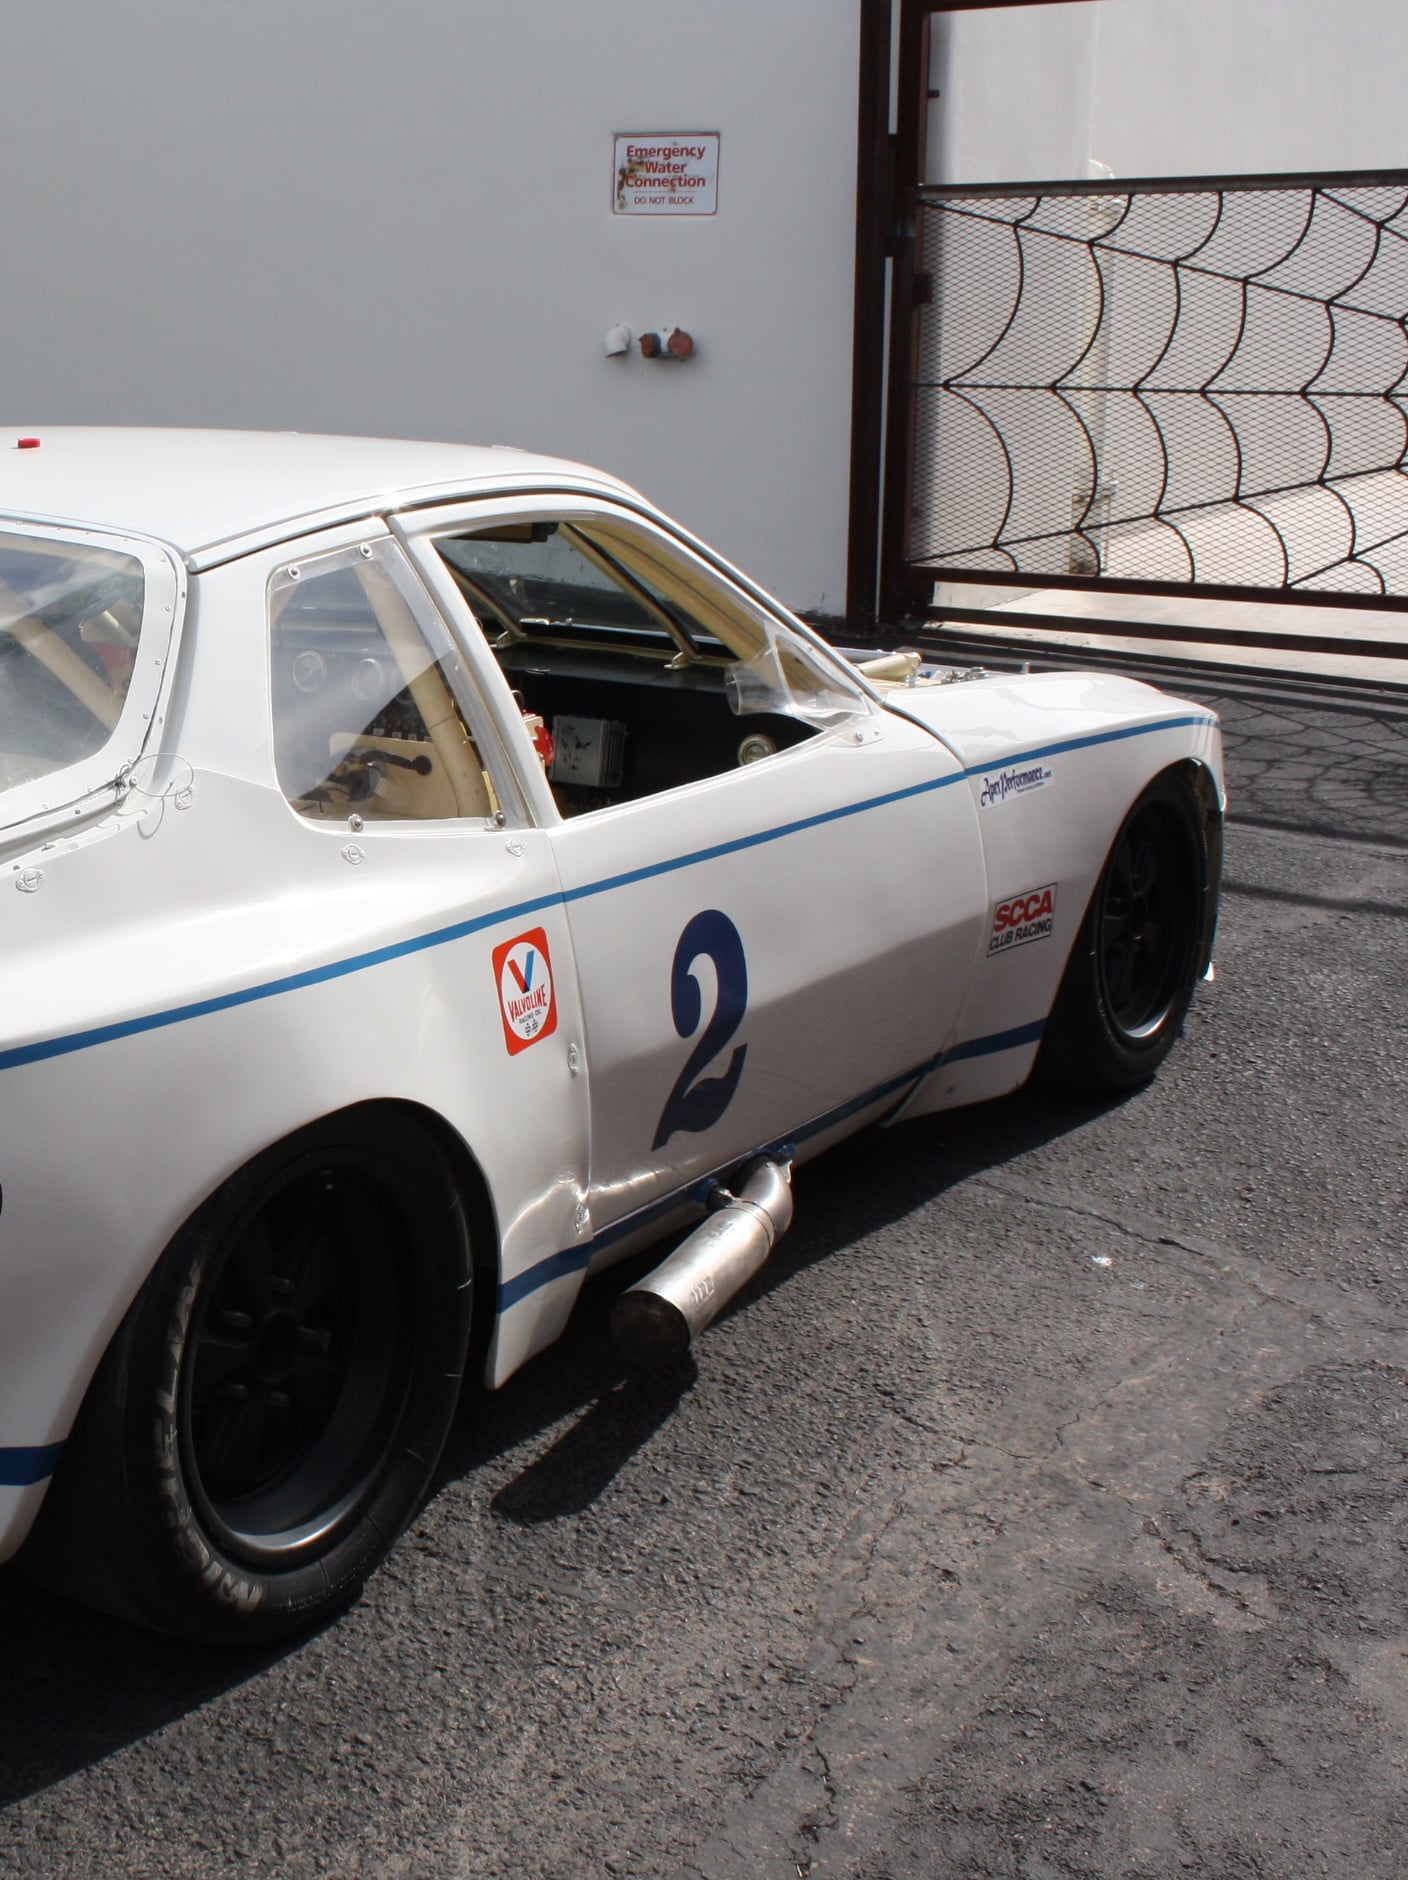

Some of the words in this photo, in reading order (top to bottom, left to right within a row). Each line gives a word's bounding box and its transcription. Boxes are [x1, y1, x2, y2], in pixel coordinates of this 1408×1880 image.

[626, 145, 706, 160] Emergency
[645, 161, 687, 174] Water
[625, 175, 706, 188] Connection
[634, 196, 646, 205] DO
[649, 196, 665, 205] NOT
[668, 196, 694, 205] BLOCK
[994, 889, 1052, 932] SCCA
[989, 930, 1014, 950] CLUB
[1015, 918, 1052, 941] RACING
[507, 984, 547, 1022] VALVOLINE
[651, 909, 748, 1152] 2
